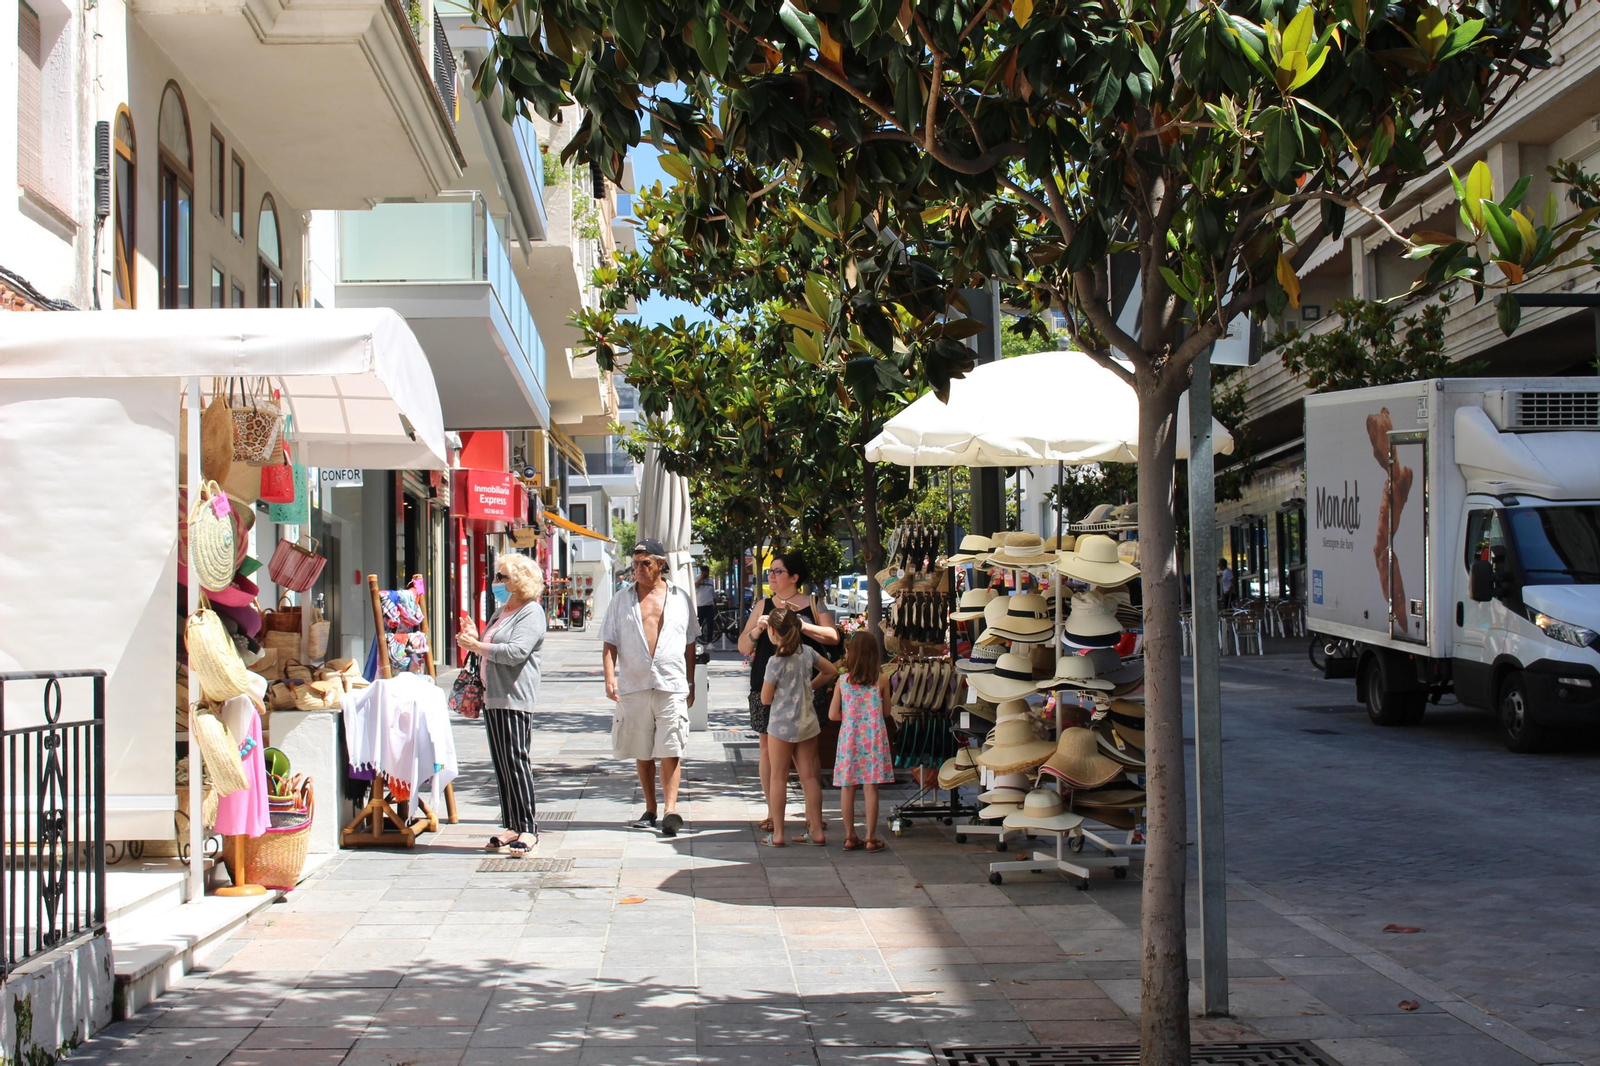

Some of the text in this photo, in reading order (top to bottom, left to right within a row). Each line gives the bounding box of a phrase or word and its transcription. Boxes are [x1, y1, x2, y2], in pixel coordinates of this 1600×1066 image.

[321, 469, 361, 481] CONFOR
[474, 484, 510, 495] Inmobiliaria
[479, 494, 507, 506] Express
[1340, 537, 1345, 549] de
